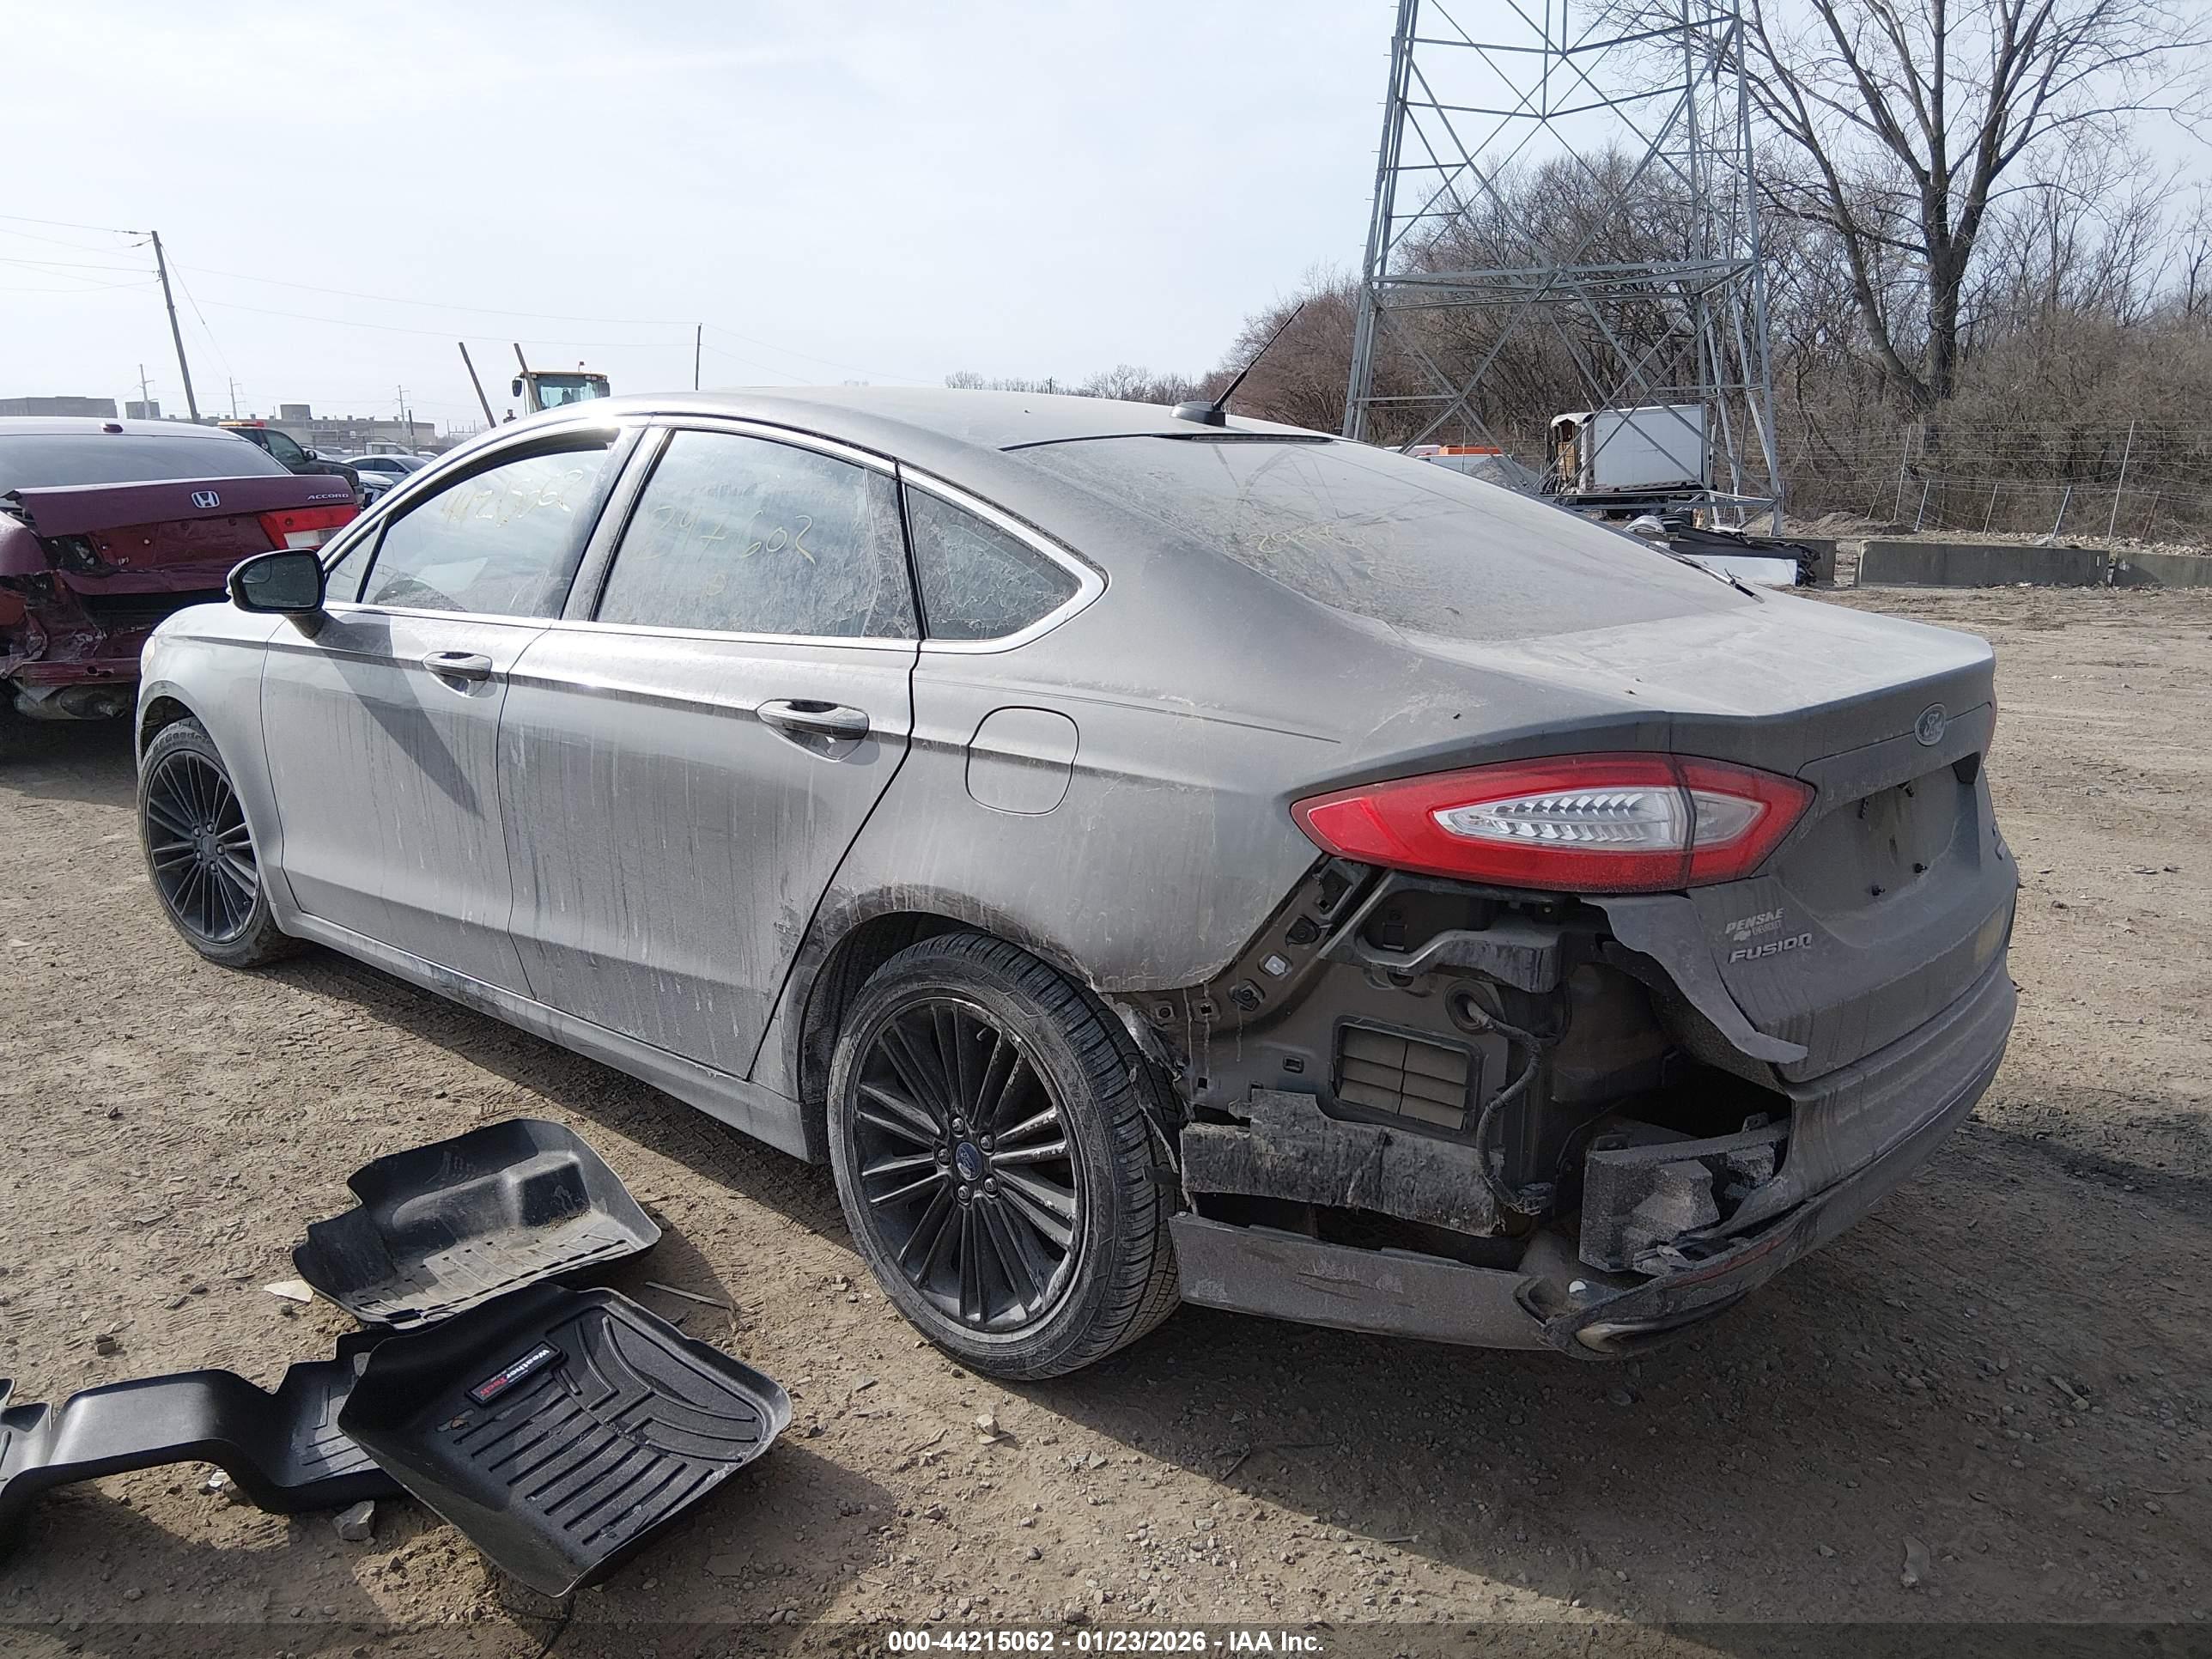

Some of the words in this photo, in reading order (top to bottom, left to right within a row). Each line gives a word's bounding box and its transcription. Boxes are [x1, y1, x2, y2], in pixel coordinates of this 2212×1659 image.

[1725, 908, 1784, 934] PENSKE
[1728, 933, 1812, 963] FUSION
[480, 1348, 550, 1396] WeatherTech
